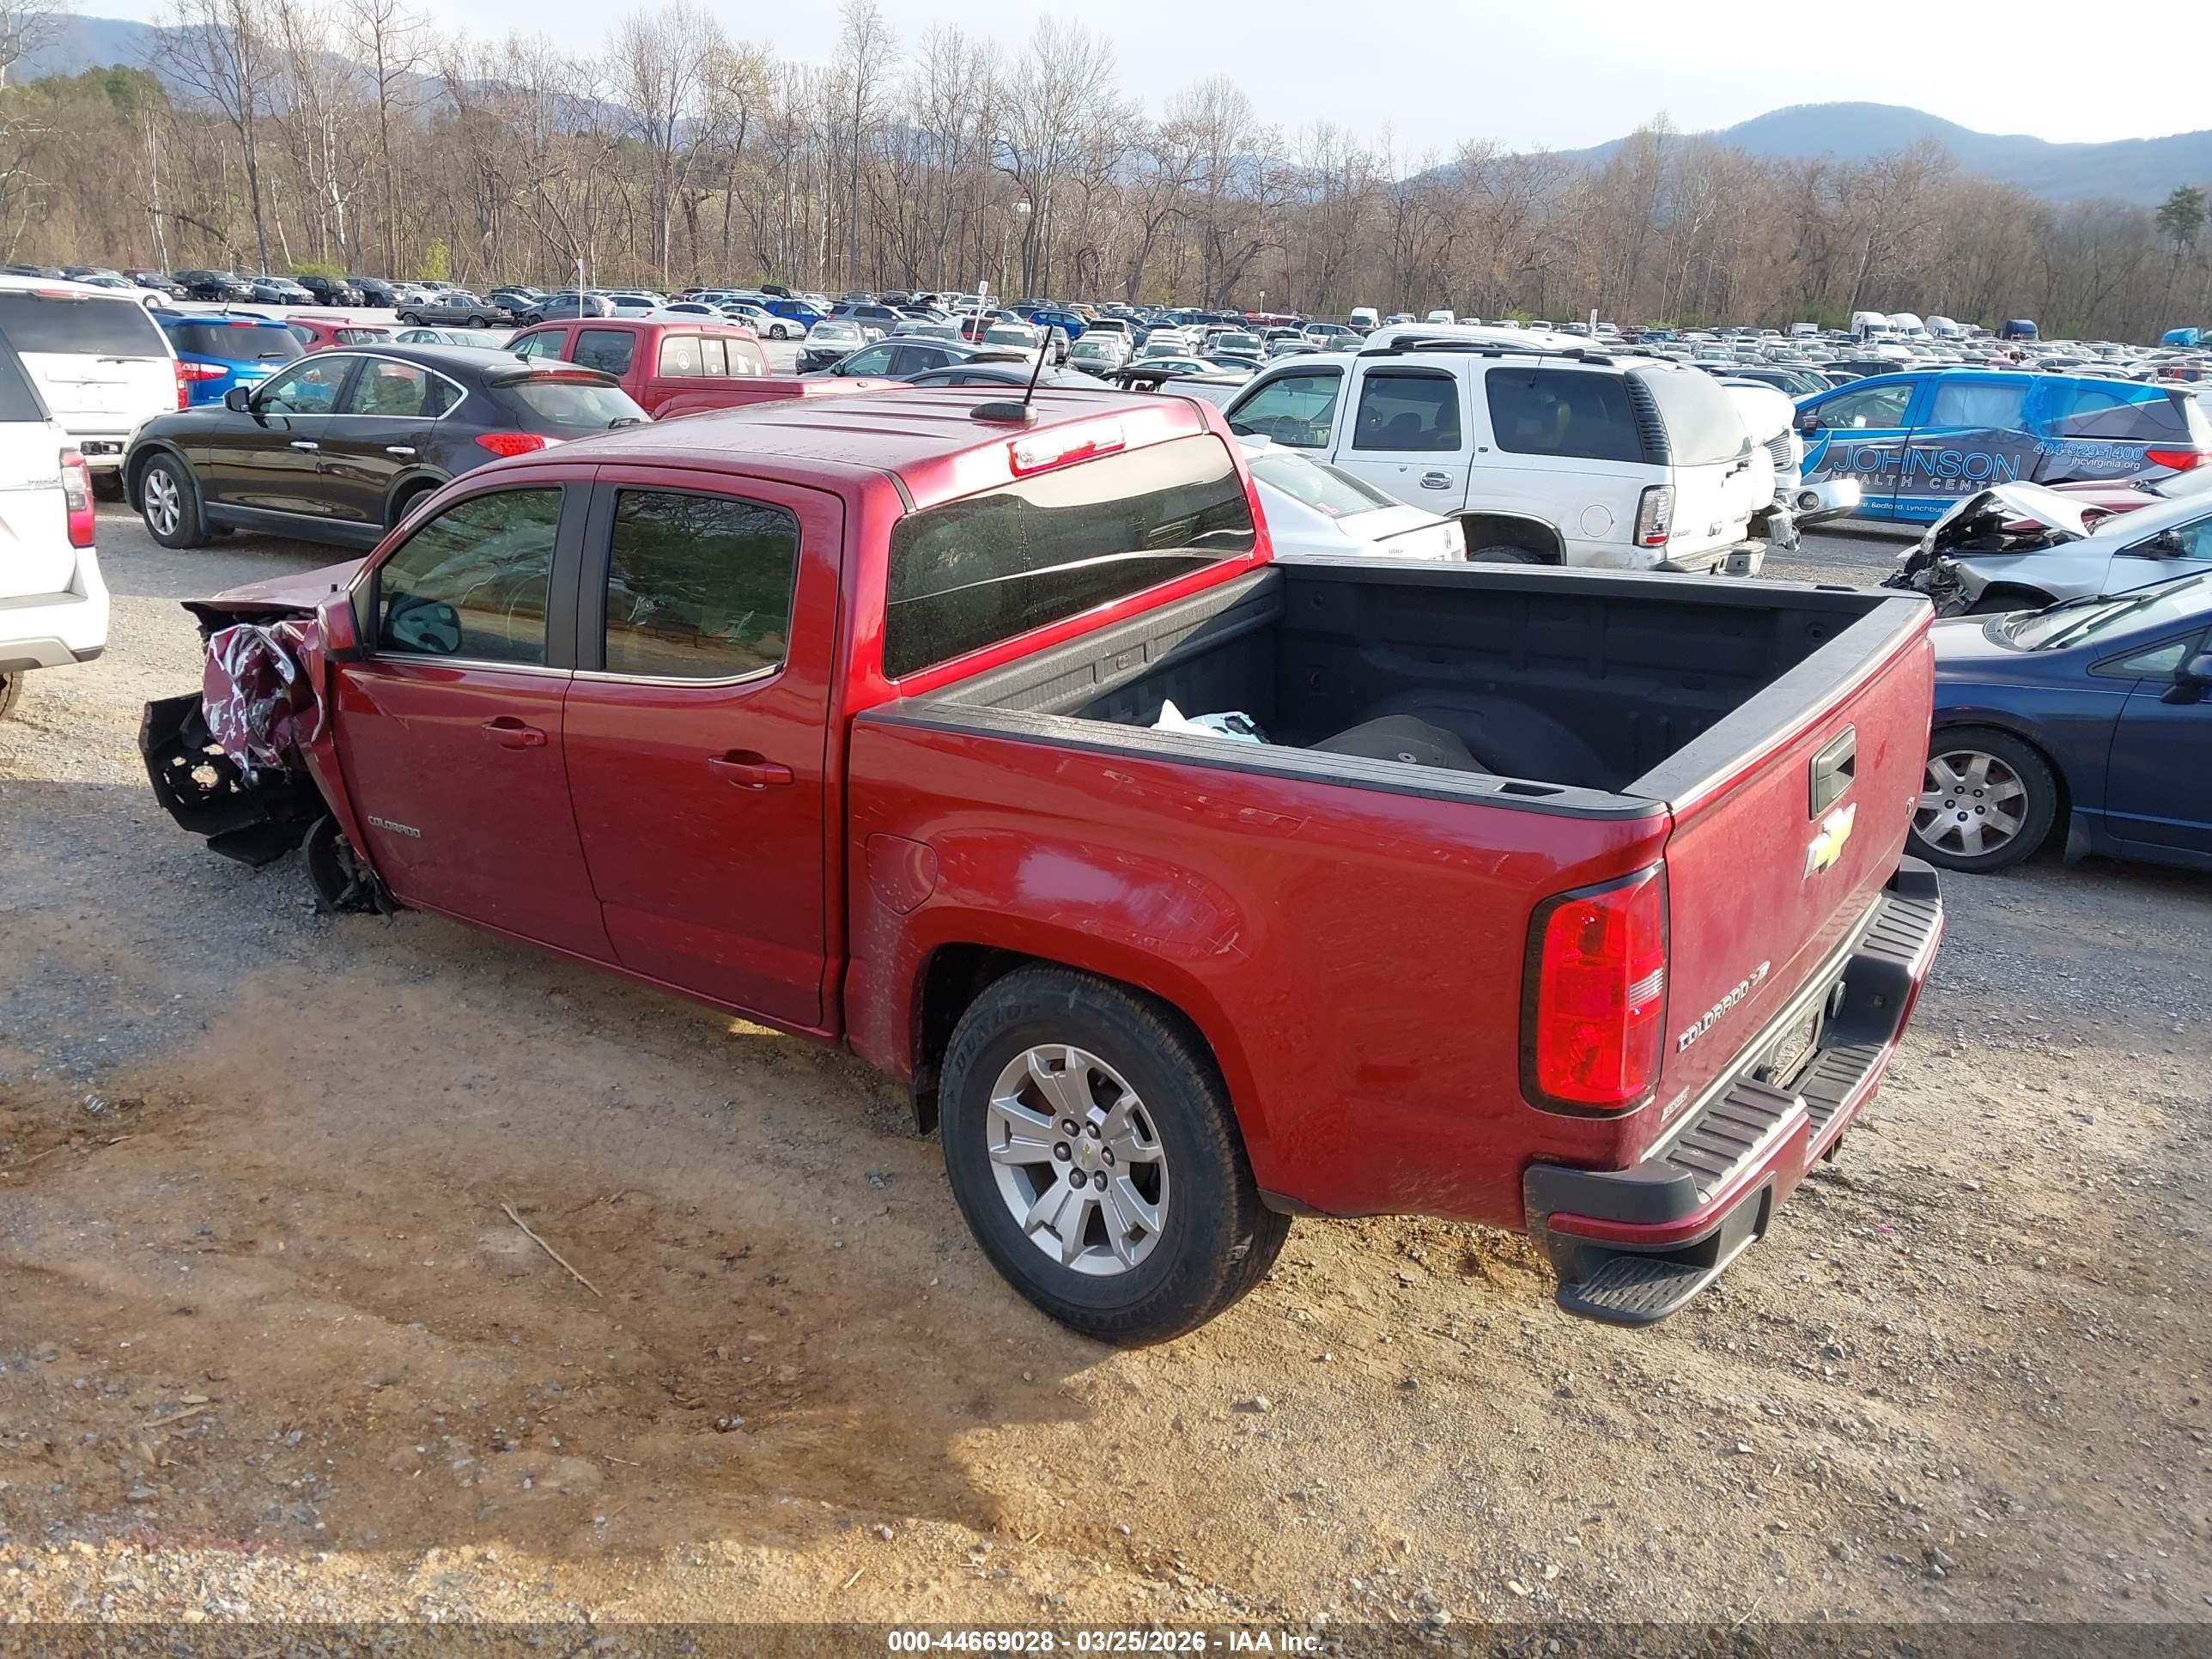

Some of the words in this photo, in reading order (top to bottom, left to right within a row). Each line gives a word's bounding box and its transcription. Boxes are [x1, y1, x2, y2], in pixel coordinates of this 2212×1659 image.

[1833, 445, 2021, 481] JOHNSON
[2070, 456, 2141, 471] jhcvirginia.org
[367, 815, 422, 838] COLORADO
[1676, 980, 1749, 1054] COLORADO
